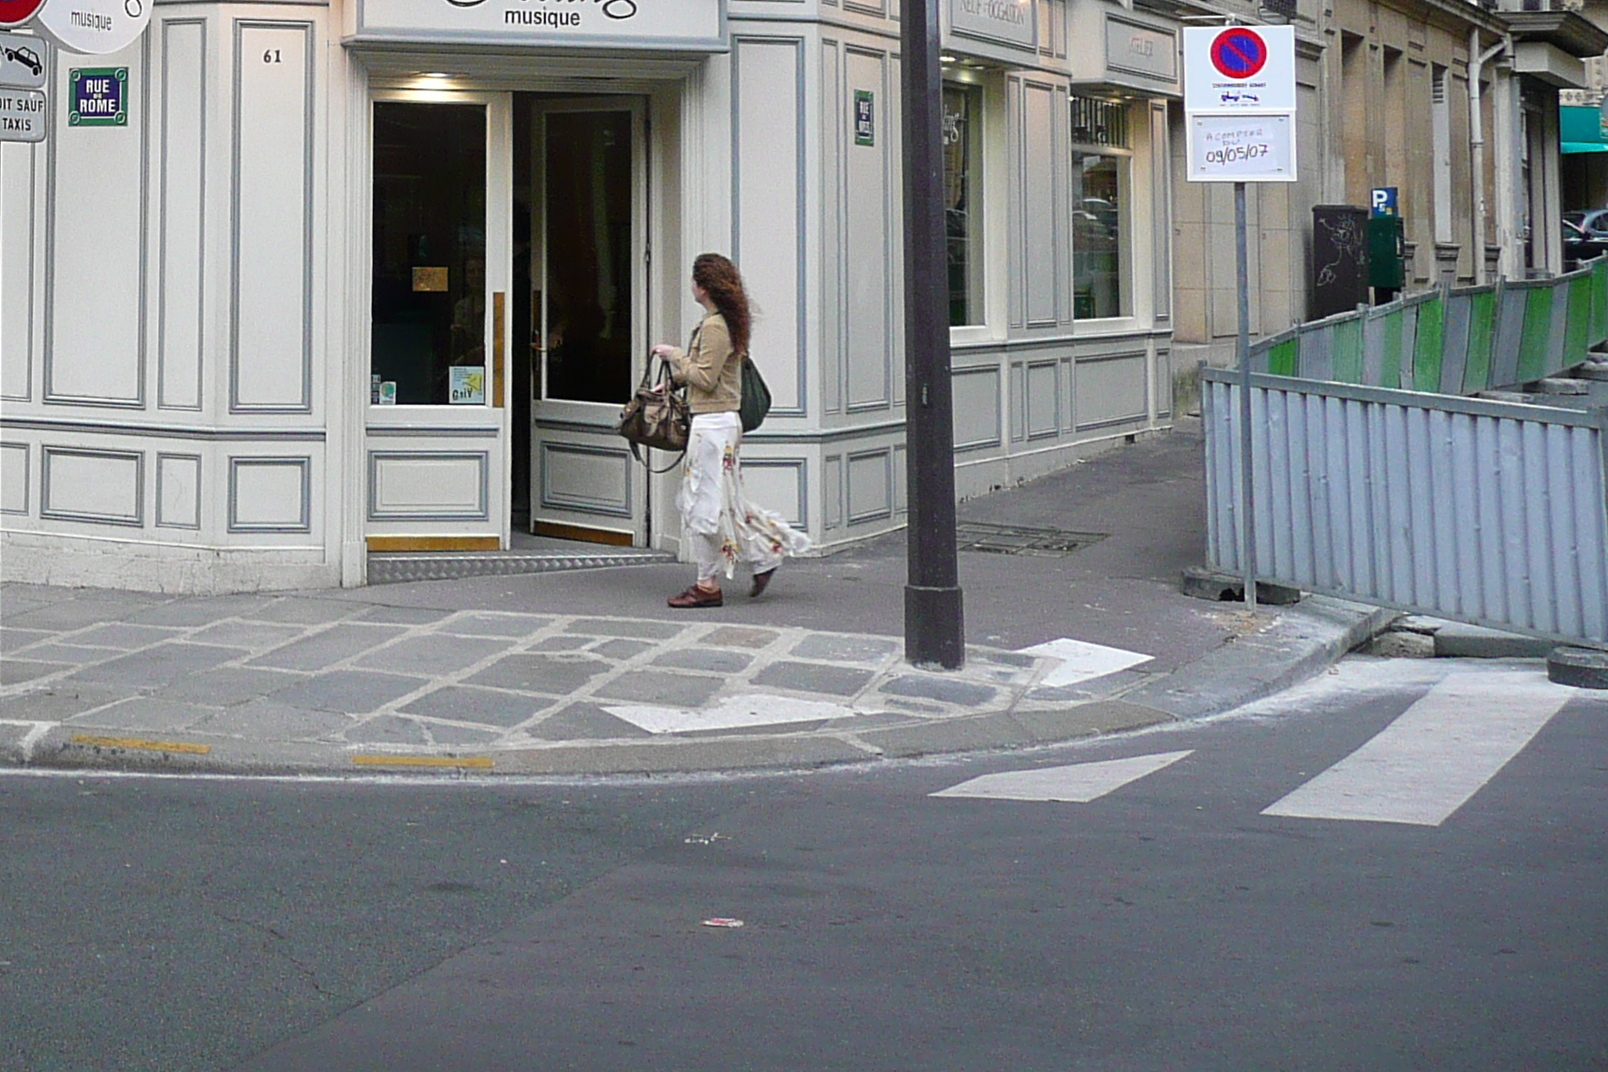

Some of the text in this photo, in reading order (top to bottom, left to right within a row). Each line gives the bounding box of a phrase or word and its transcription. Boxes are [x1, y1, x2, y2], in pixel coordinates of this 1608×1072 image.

[71, 11, 112, 31] musique
[504, 6, 581, 28] musique
[263, 49, 282, 64] 61
[85, 79, 110, 93] RUE
[17, 99, 44, 113] SAUF
[80, 99, 116, 113] ROME
[3, 118, 32, 131] TAXIS
[1206, 144, 1268, 166] 09/05/07
[1372, 190, 1388, 207] P
